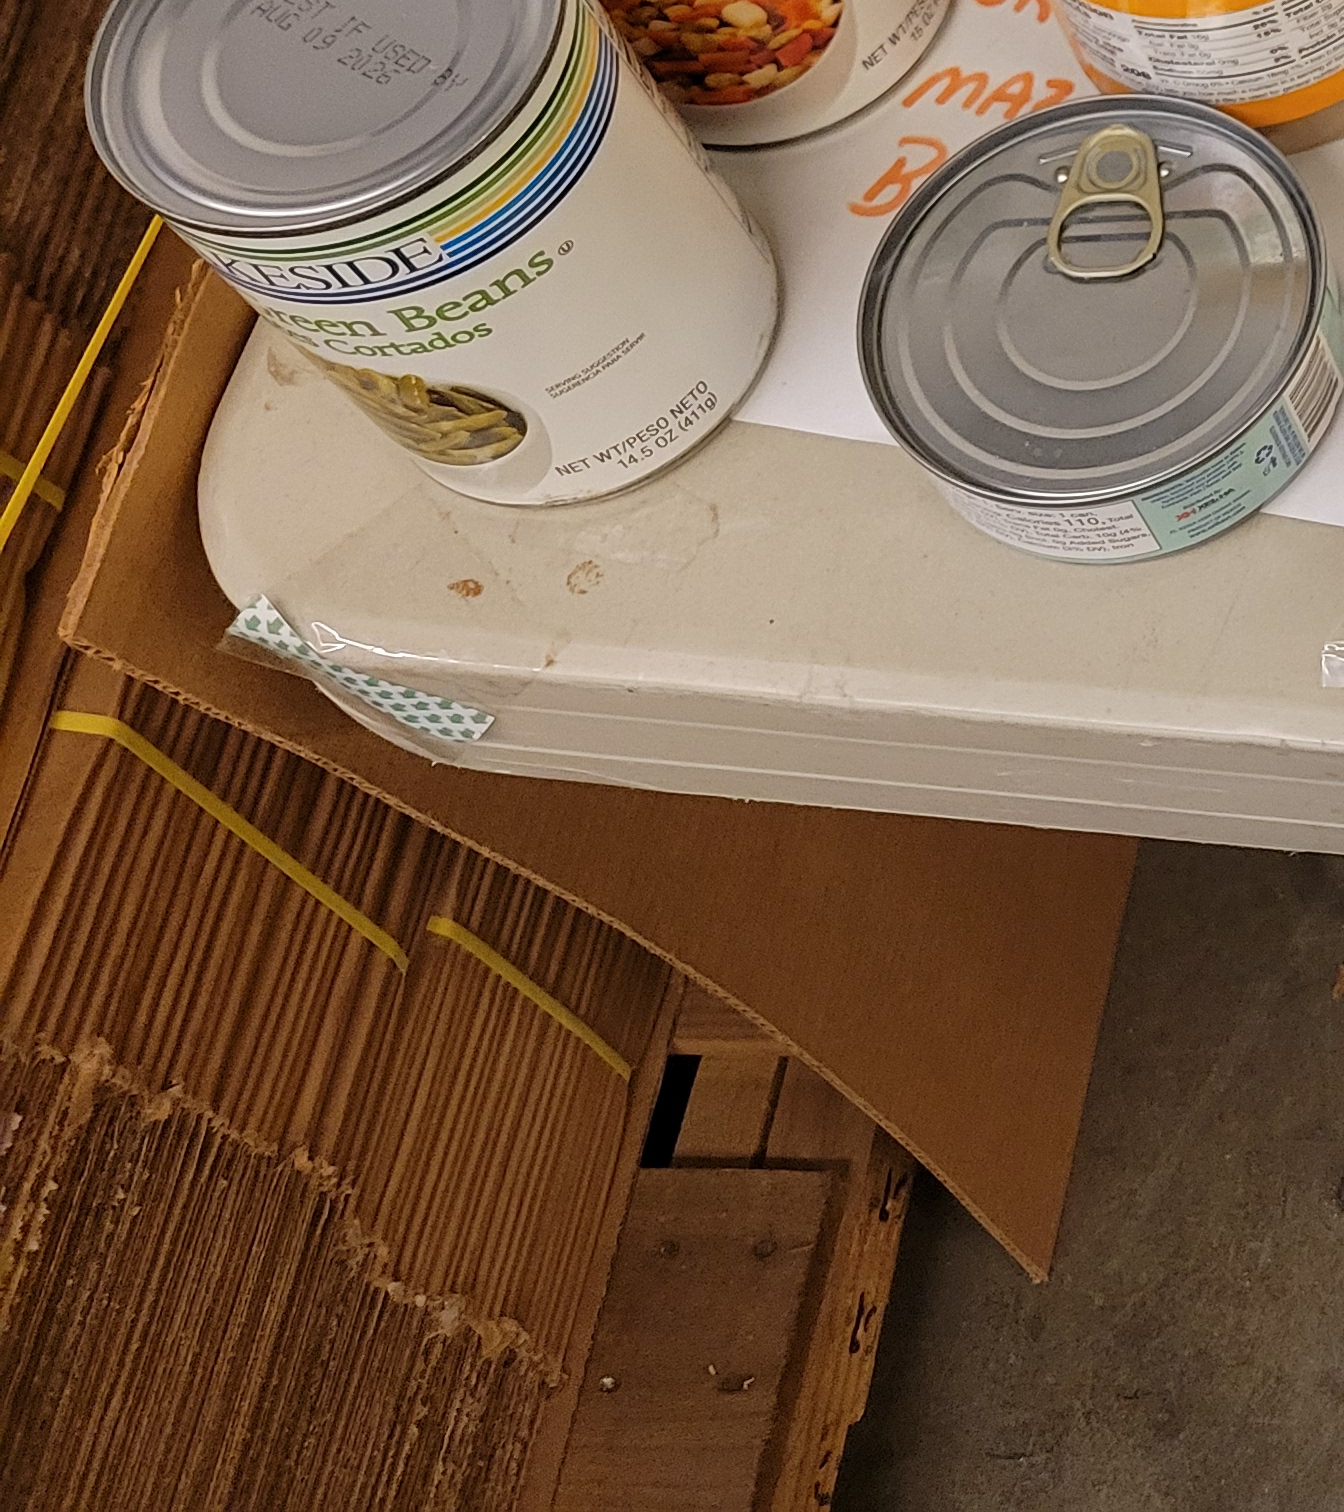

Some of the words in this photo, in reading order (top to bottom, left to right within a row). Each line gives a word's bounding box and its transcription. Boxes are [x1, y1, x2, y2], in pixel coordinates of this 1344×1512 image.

[250, 0, 300, 31] AUG
[303, 27, 337, 50] 09
[372, 35, 432, 74] USED
[861, 43, 889, 71] NET
[210, 237, 444, 291] KESIDE
[387, 250, 555, 333] Beans
[323, 322, 494, 358] Cortados
[545, 372, 582, 394] SERVING
[581, 338, 630, 374] SUGGESTION
[601, 354, 622, 371] PARA
[555, 457, 591, 476] NET
[593, 417, 669, 463] WT/PESO
[669, 381, 708, 420] NETO
[617, 445, 654, 469] 14.5
[655, 429, 679, 449] OZ
[678, 392, 718, 432] (411g)
